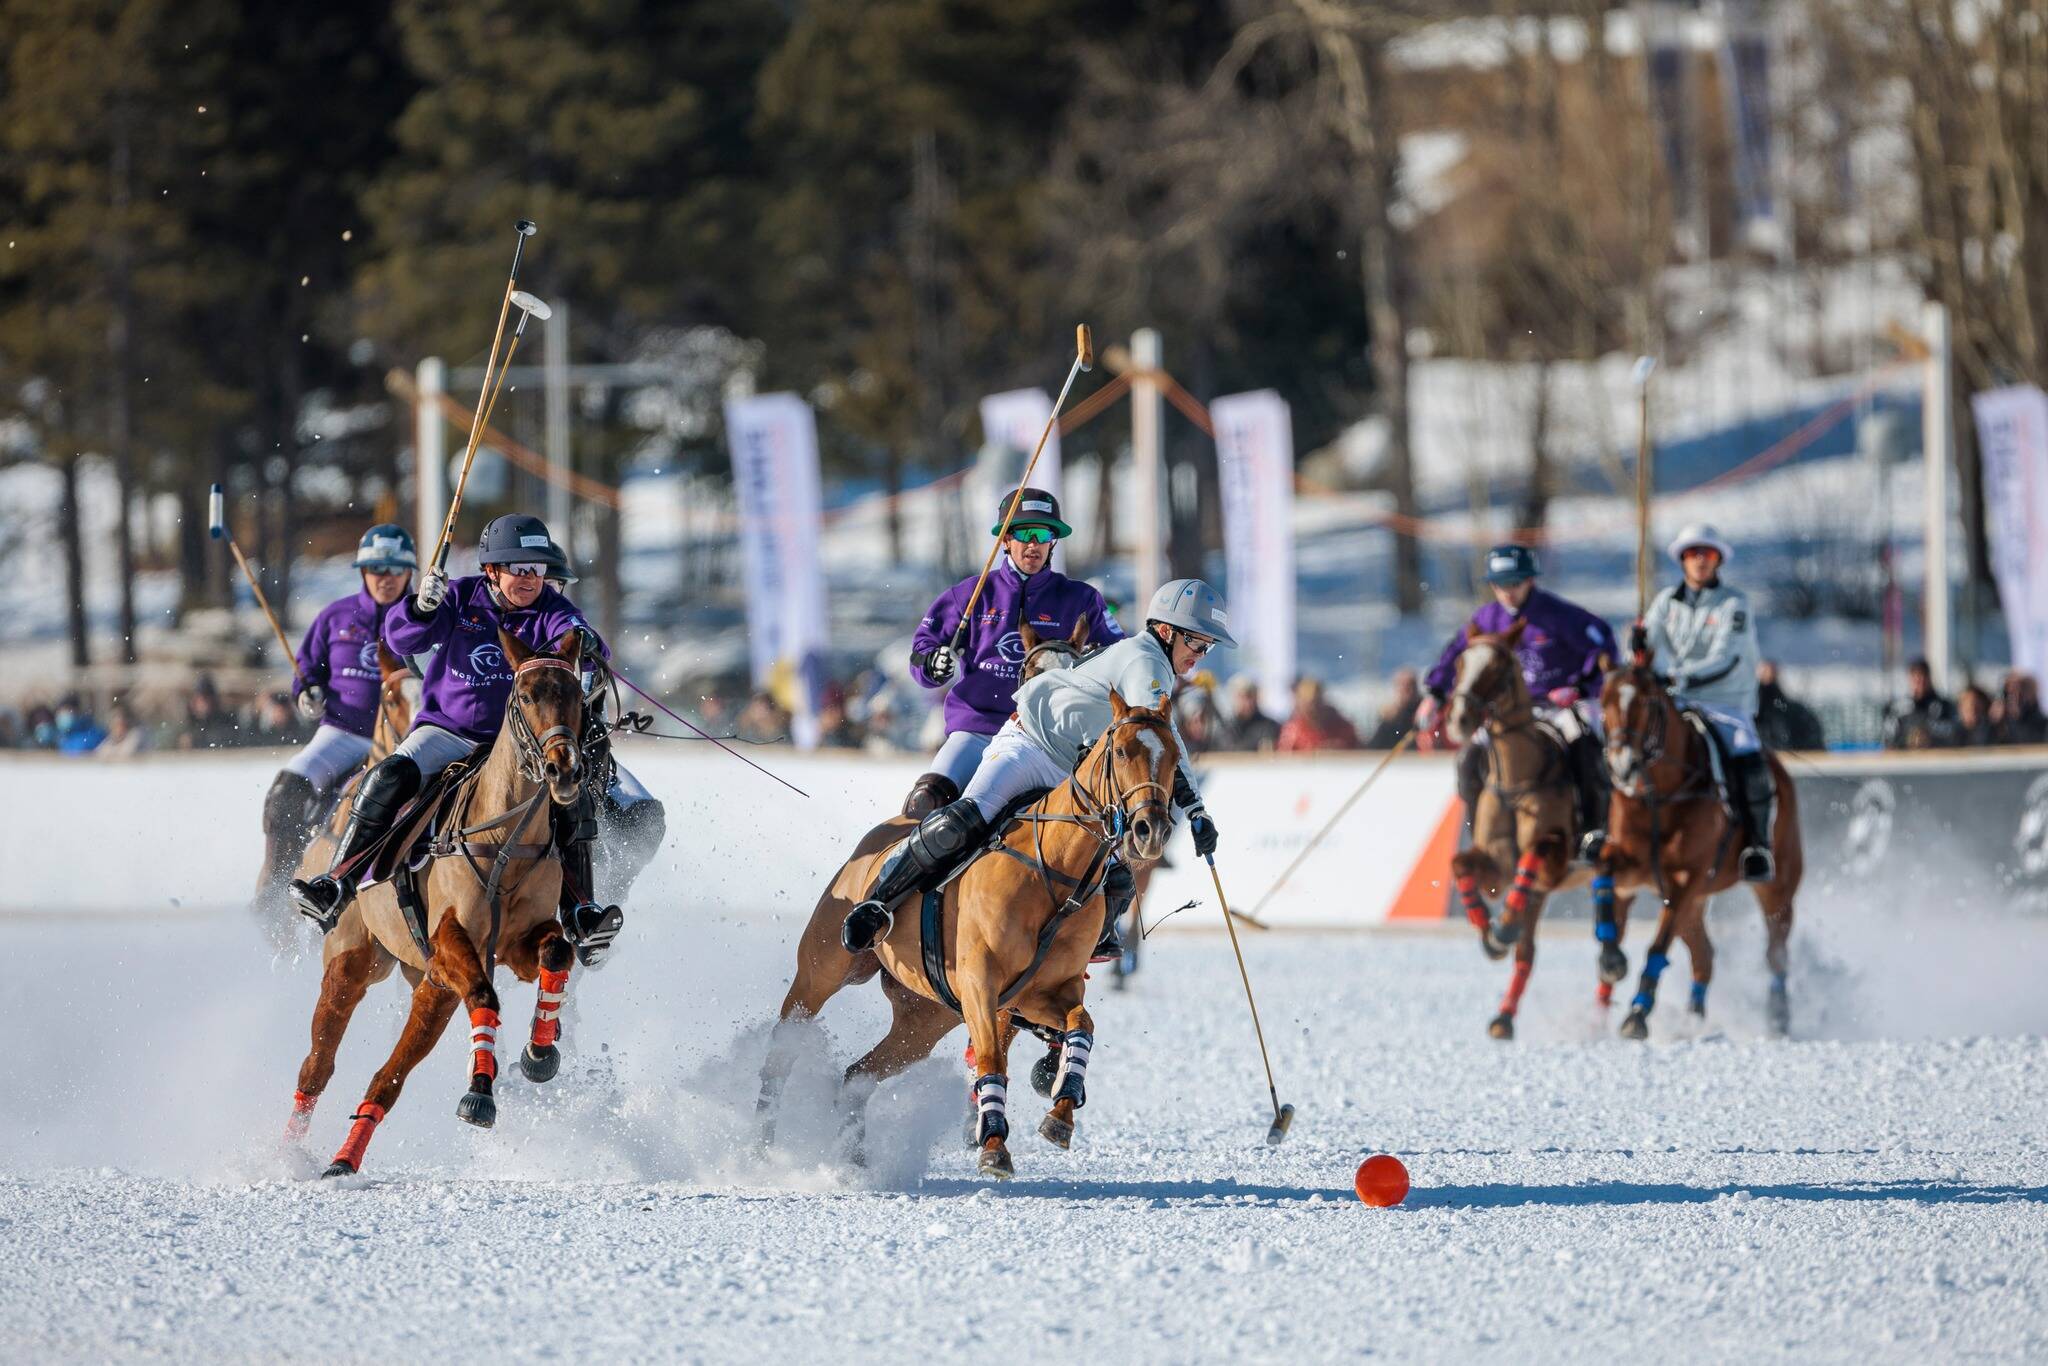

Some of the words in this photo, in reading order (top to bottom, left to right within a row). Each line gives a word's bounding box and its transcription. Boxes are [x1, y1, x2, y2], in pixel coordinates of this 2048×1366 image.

[978, 661, 1014, 673] WORLD
[484, 673, 514, 681] POLO
[995, 671, 1019, 679] LEAG
